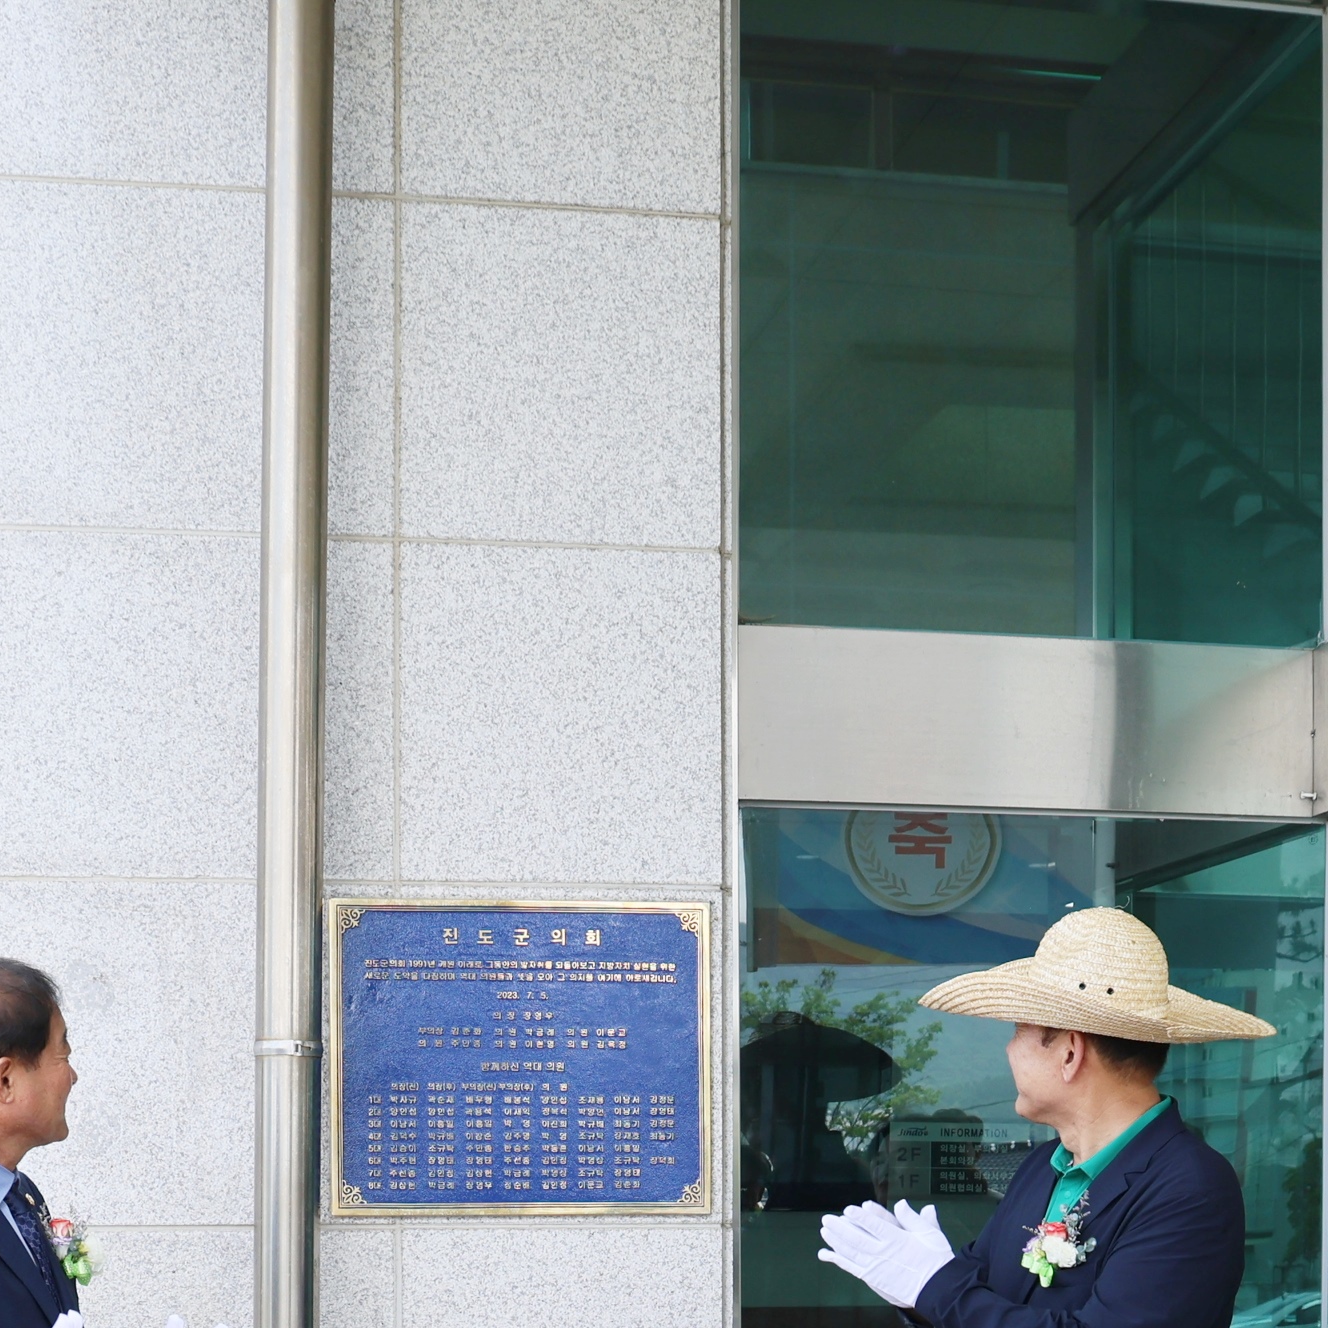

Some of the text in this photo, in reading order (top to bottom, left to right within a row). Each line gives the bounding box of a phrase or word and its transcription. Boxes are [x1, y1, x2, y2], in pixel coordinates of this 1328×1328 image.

[364, 959, 406, 968] 진도군의회
[408, 960, 437, 968] 1991년
[485, 960, 518, 969] 그동안의
[555, 961, 596, 970] 되돌아보고
[598, 962, 630, 971] 지방자치
[660, 963, 676, 972] 위한
[364, 971, 390, 980] 새로운
[394, 972, 419, 980] 도약을
[460, 972, 477, 981] 역대
[480, 973, 513, 981] 의원들과
[537, 973, 554, 982] 모아
[570, 974, 594, 982] 의지를
[597, 974, 622, 982] 여기에
[496, 991, 520, 1000] 2023.
[492, 1011, 516, 1021] 의장
[418, 1027, 444, 1036] 부의장
[494, 1027, 517, 1037] 의원
[566, 1028, 588, 1037] 의원
[418, 1039, 443, 1048] 의원
[494, 1040, 517, 1049] 의원
[566, 1040, 589, 1049] 의원
[480, 1062, 565, 1072] 함께하신 역대 의원
[368, 1095, 382, 1104] 1대
[368, 1107, 382, 1116] 2대
[368, 1120, 382, 1128] 3대
[940, 1128, 1008, 1138] INFORMATION
[368, 1144, 382, 1153] 5대
[897, 1147, 921, 1162] 2F
[898, 1174, 920, 1189] 1F
